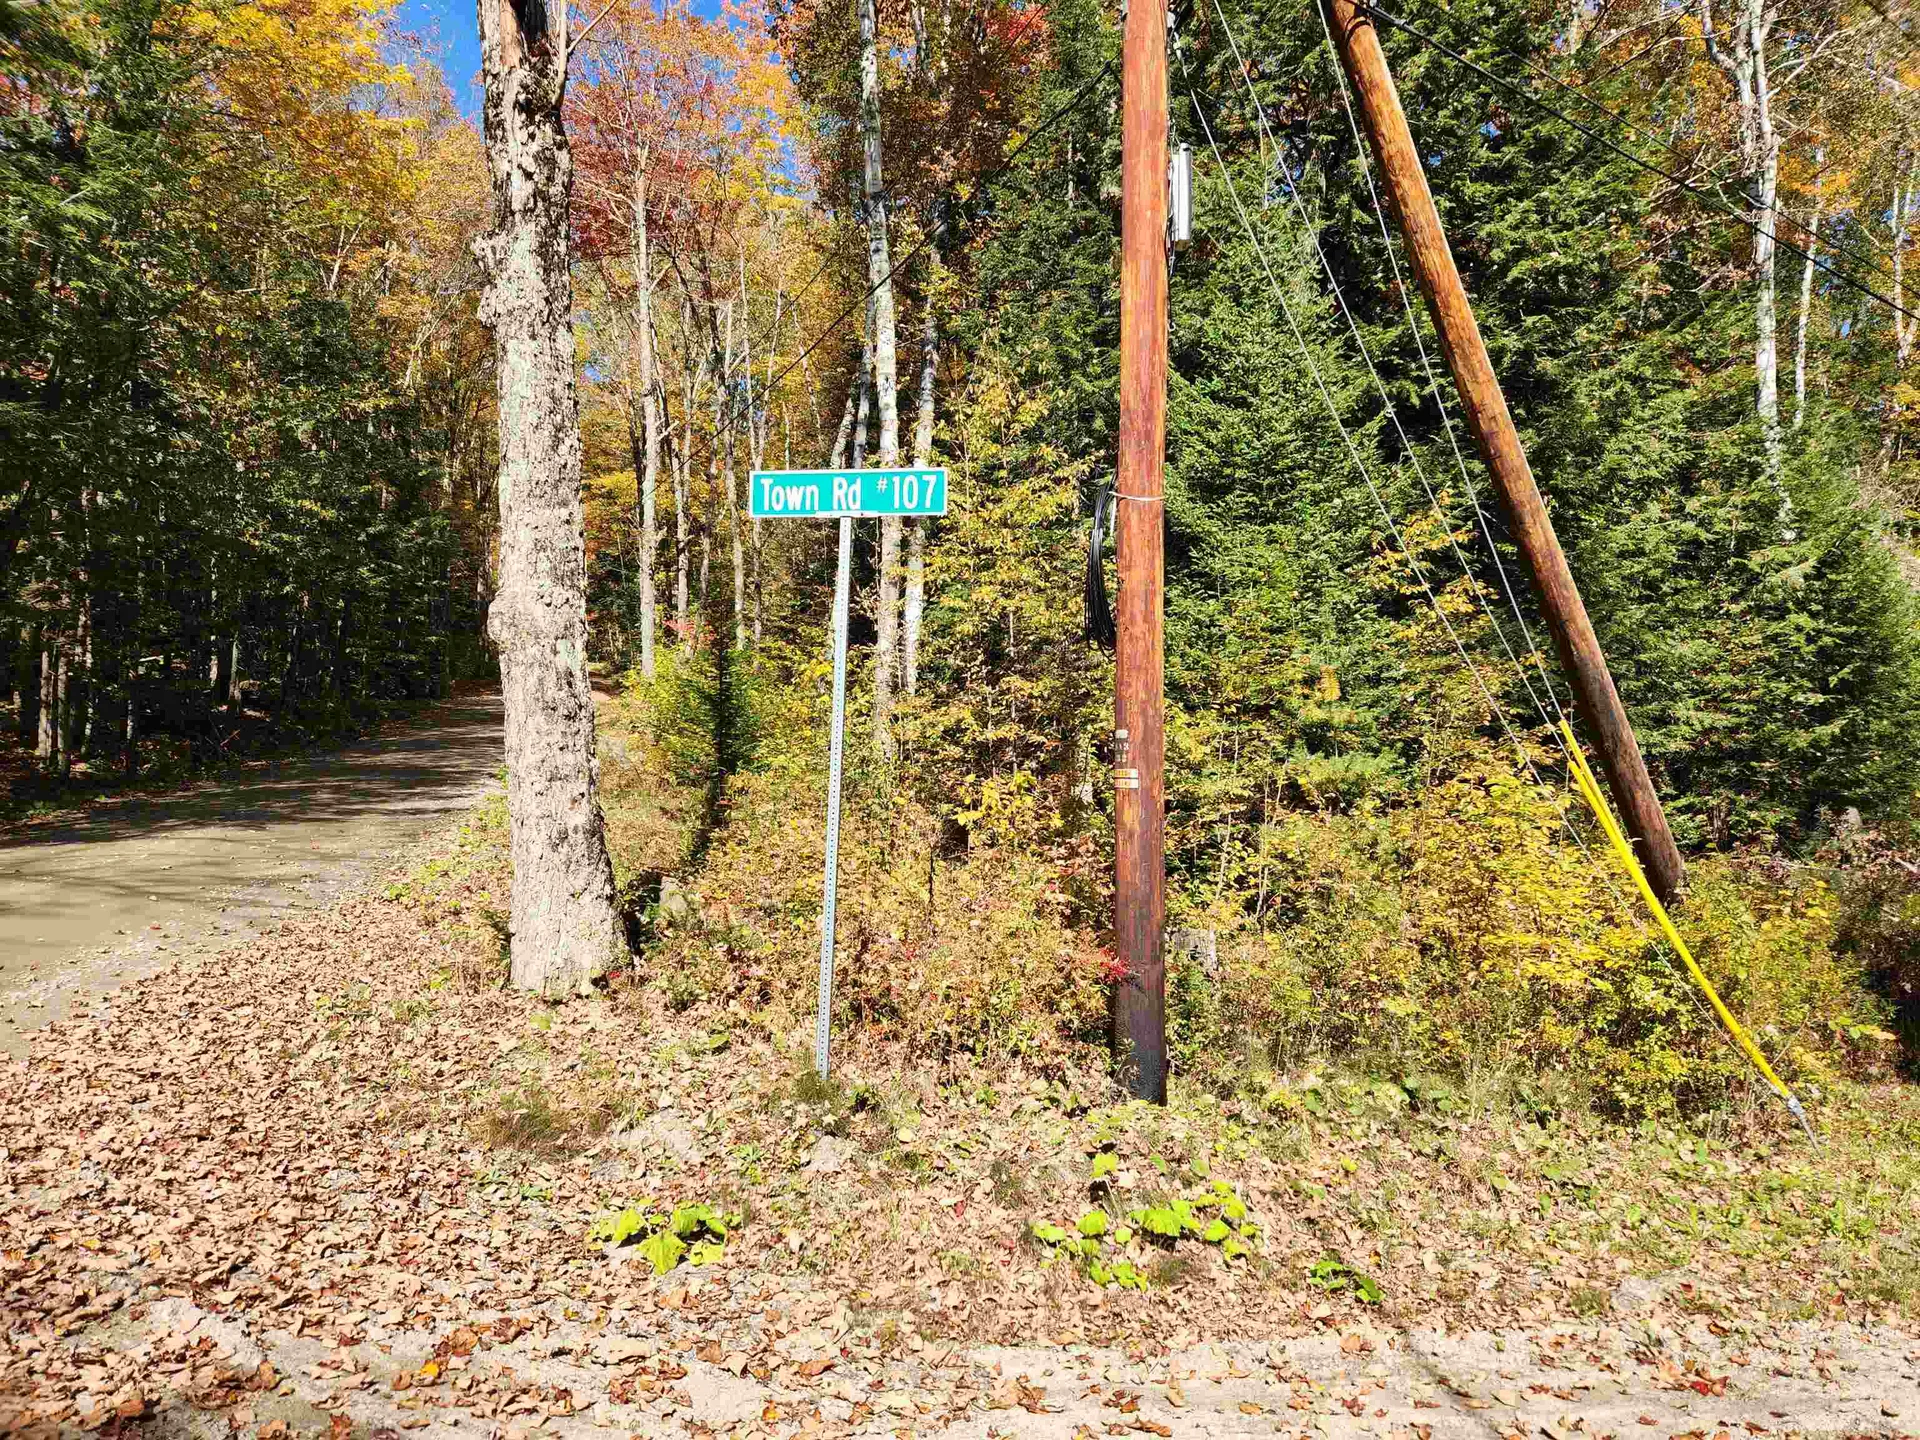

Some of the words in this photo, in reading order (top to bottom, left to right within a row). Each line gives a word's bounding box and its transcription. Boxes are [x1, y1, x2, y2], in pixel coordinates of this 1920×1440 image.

[760, 477, 819, 511] Town
[832, 476, 862, 511] Rd
[876, 475, 937, 510] #107
